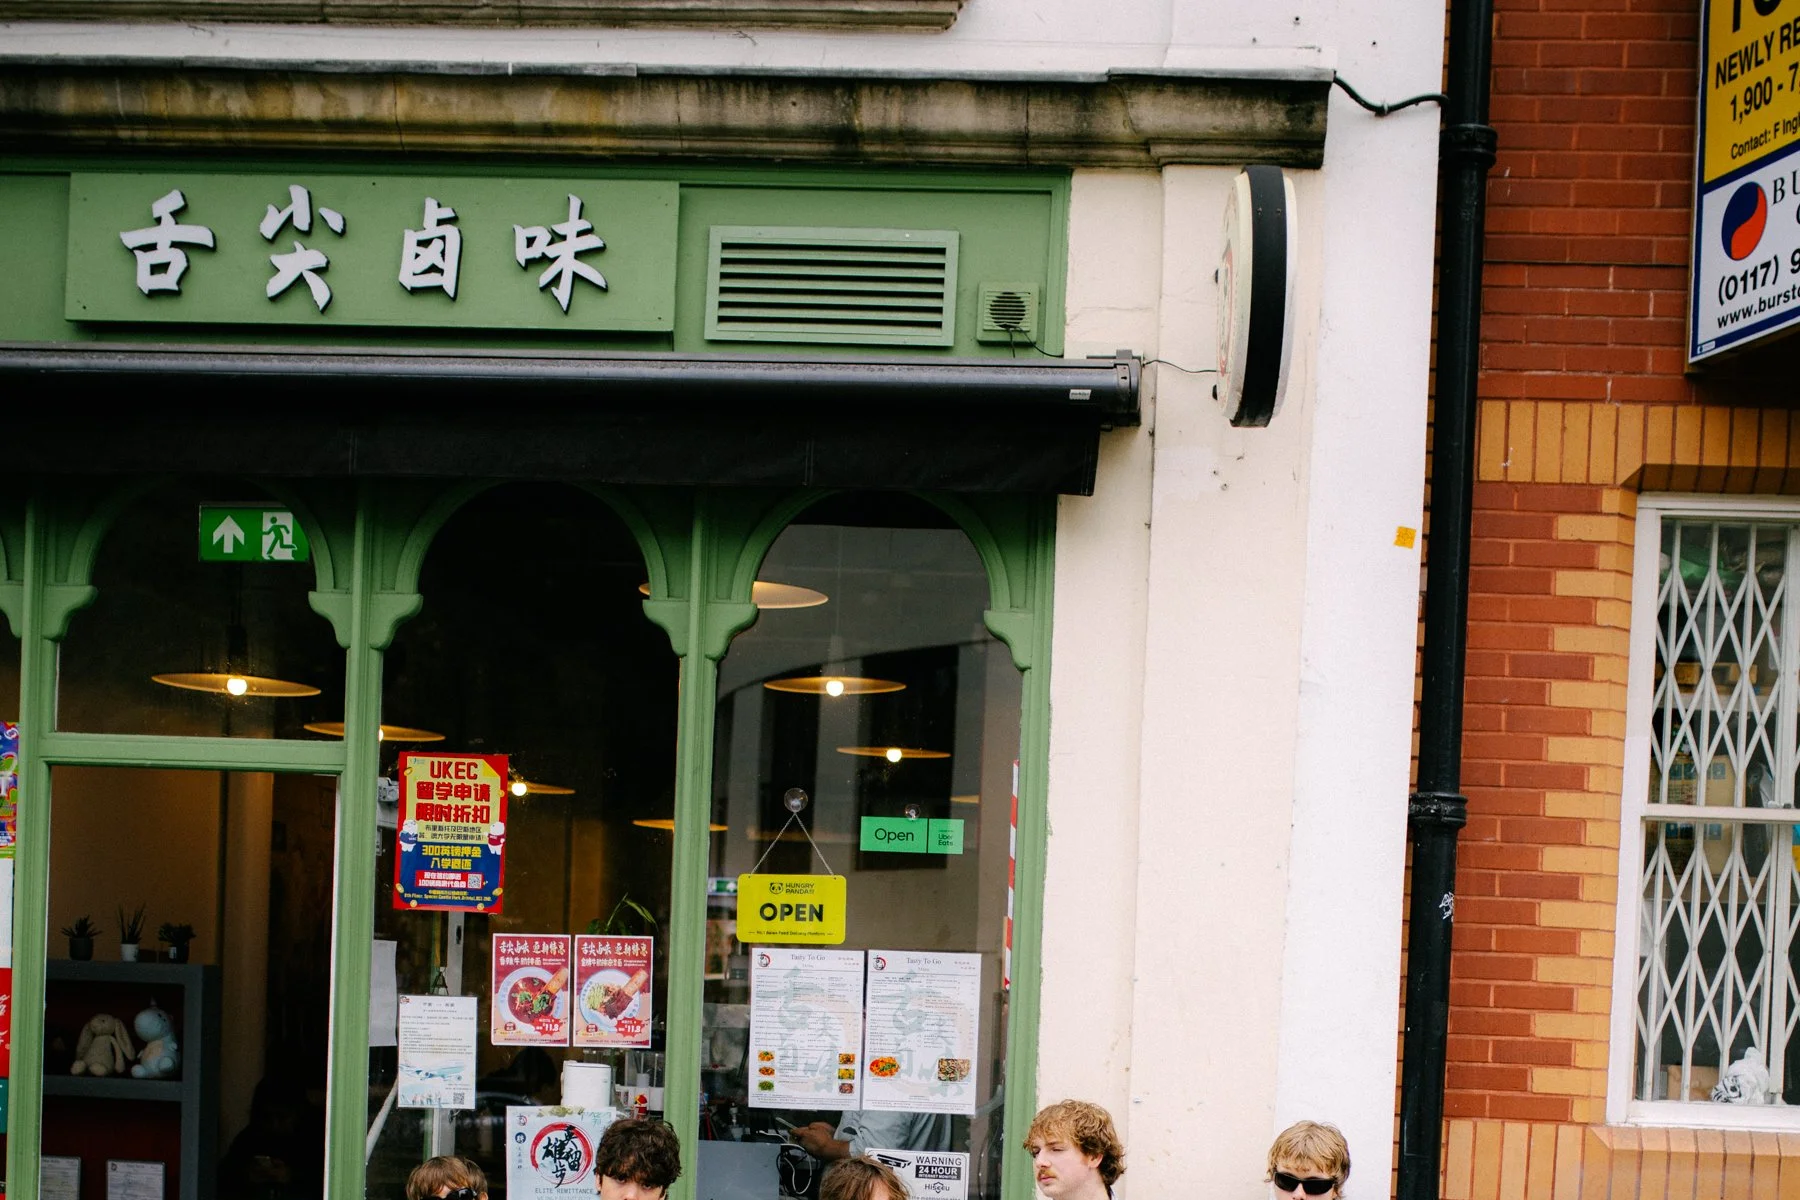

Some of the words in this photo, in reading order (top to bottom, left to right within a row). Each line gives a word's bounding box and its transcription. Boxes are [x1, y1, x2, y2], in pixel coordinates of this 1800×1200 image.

[1715, 30, 1775, 90] NEWLY
[1730, 75, 1773, 125] 1,900
[1730, 128, 1771, 160] Contact:
[1773, 121, 1780, 139] F
[120, 184, 609, 314] 舌尖卤味
[1718, 254, 1780, 306] (0117)
[430, 761, 478, 780] UKEC
[416, 781, 491, 802] 留学申请
[415, 802, 490, 824] 限时折扣
[874, 828, 914, 844] Open
[760, 902, 824, 922] OPEN
[791, 954, 805, 962] Tasty
[916, 1156, 962, 1166] WARNING
[918, 1166, 929, 1174] 24
[931, 1167, 958, 1175] HOUR
